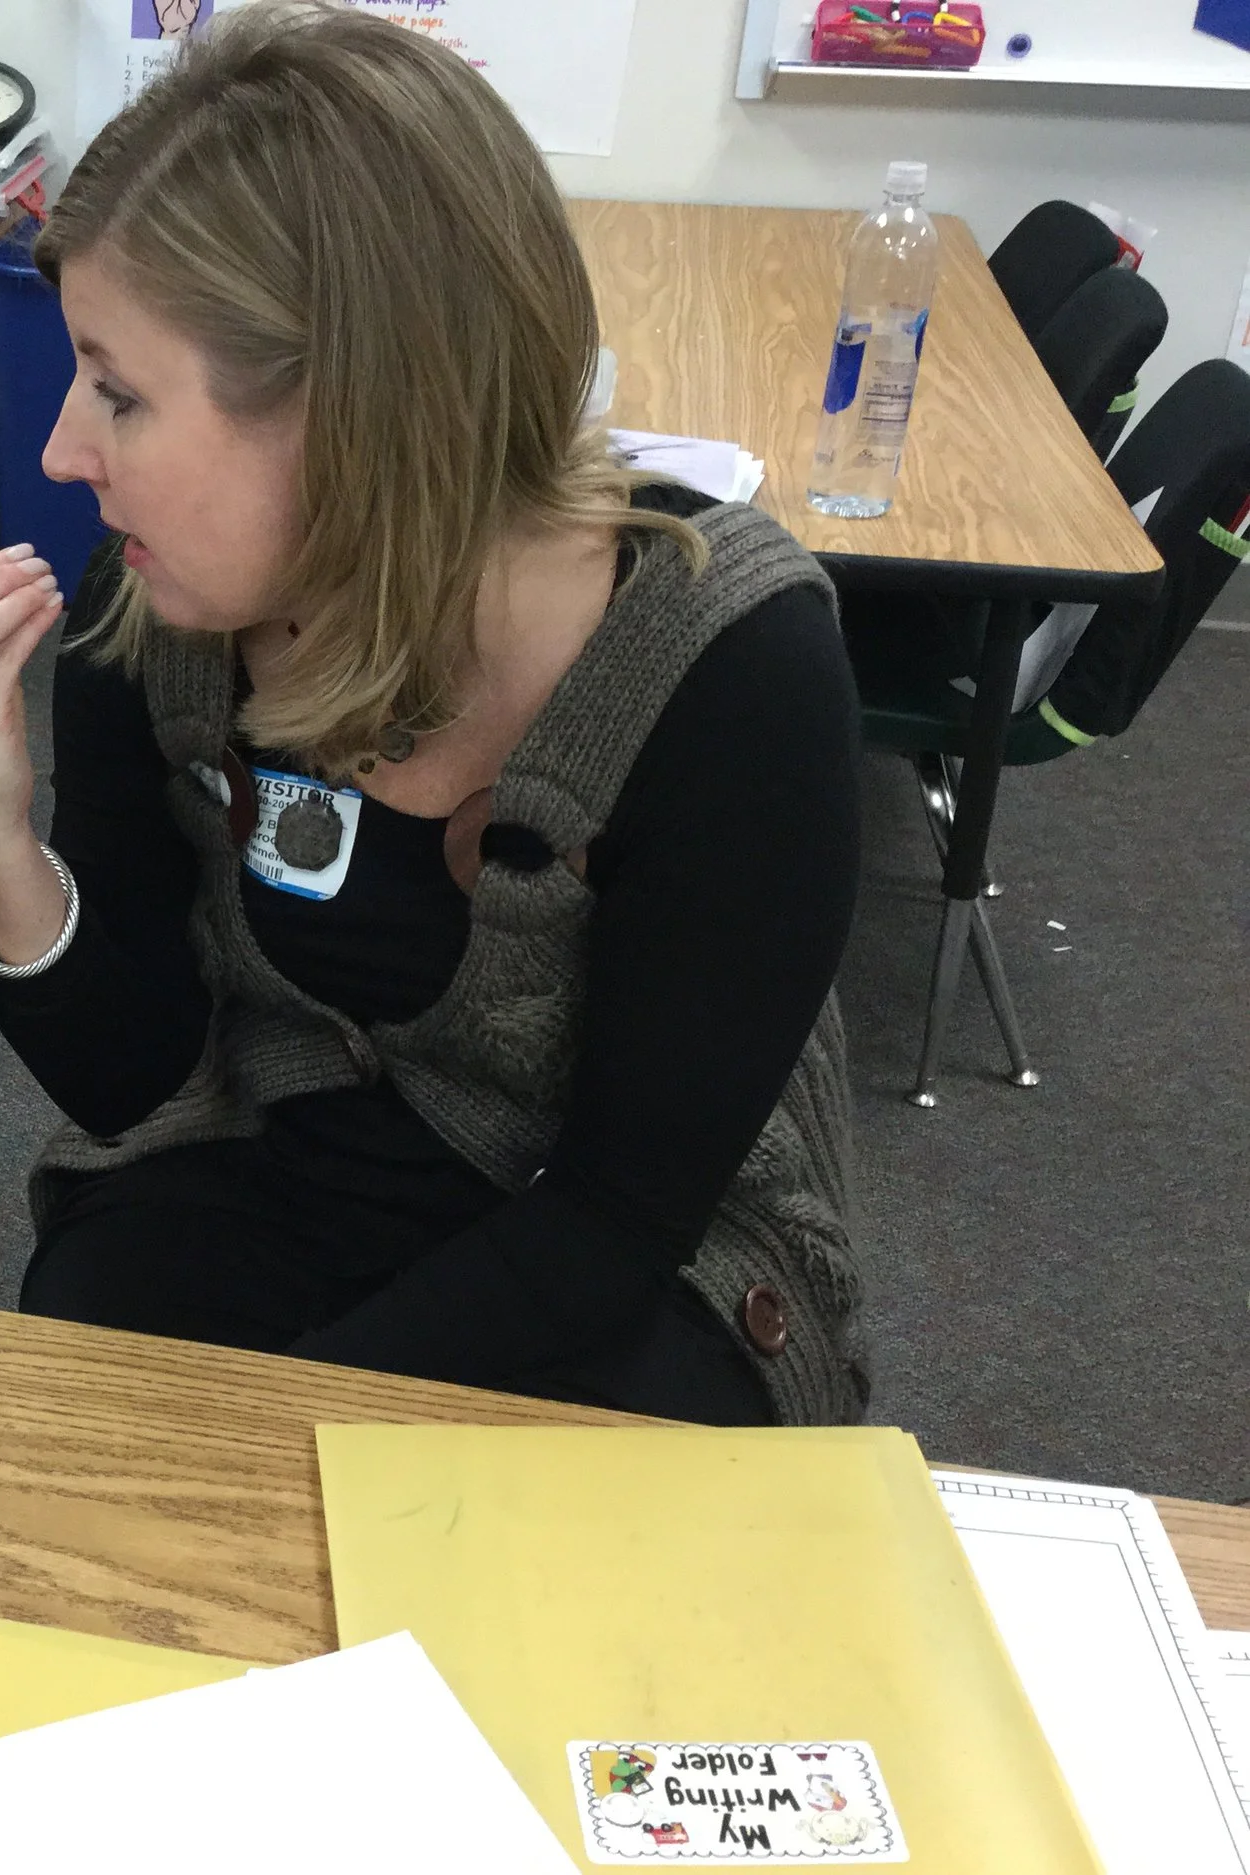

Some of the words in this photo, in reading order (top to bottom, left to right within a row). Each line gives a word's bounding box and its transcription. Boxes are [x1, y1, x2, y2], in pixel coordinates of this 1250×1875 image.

[411, 18, 447, 34] pages.
[671, 1751, 778, 1777] Folder
[665, 1776, 802, 1813] Writing
[719, 1813, 771, 1850] My
